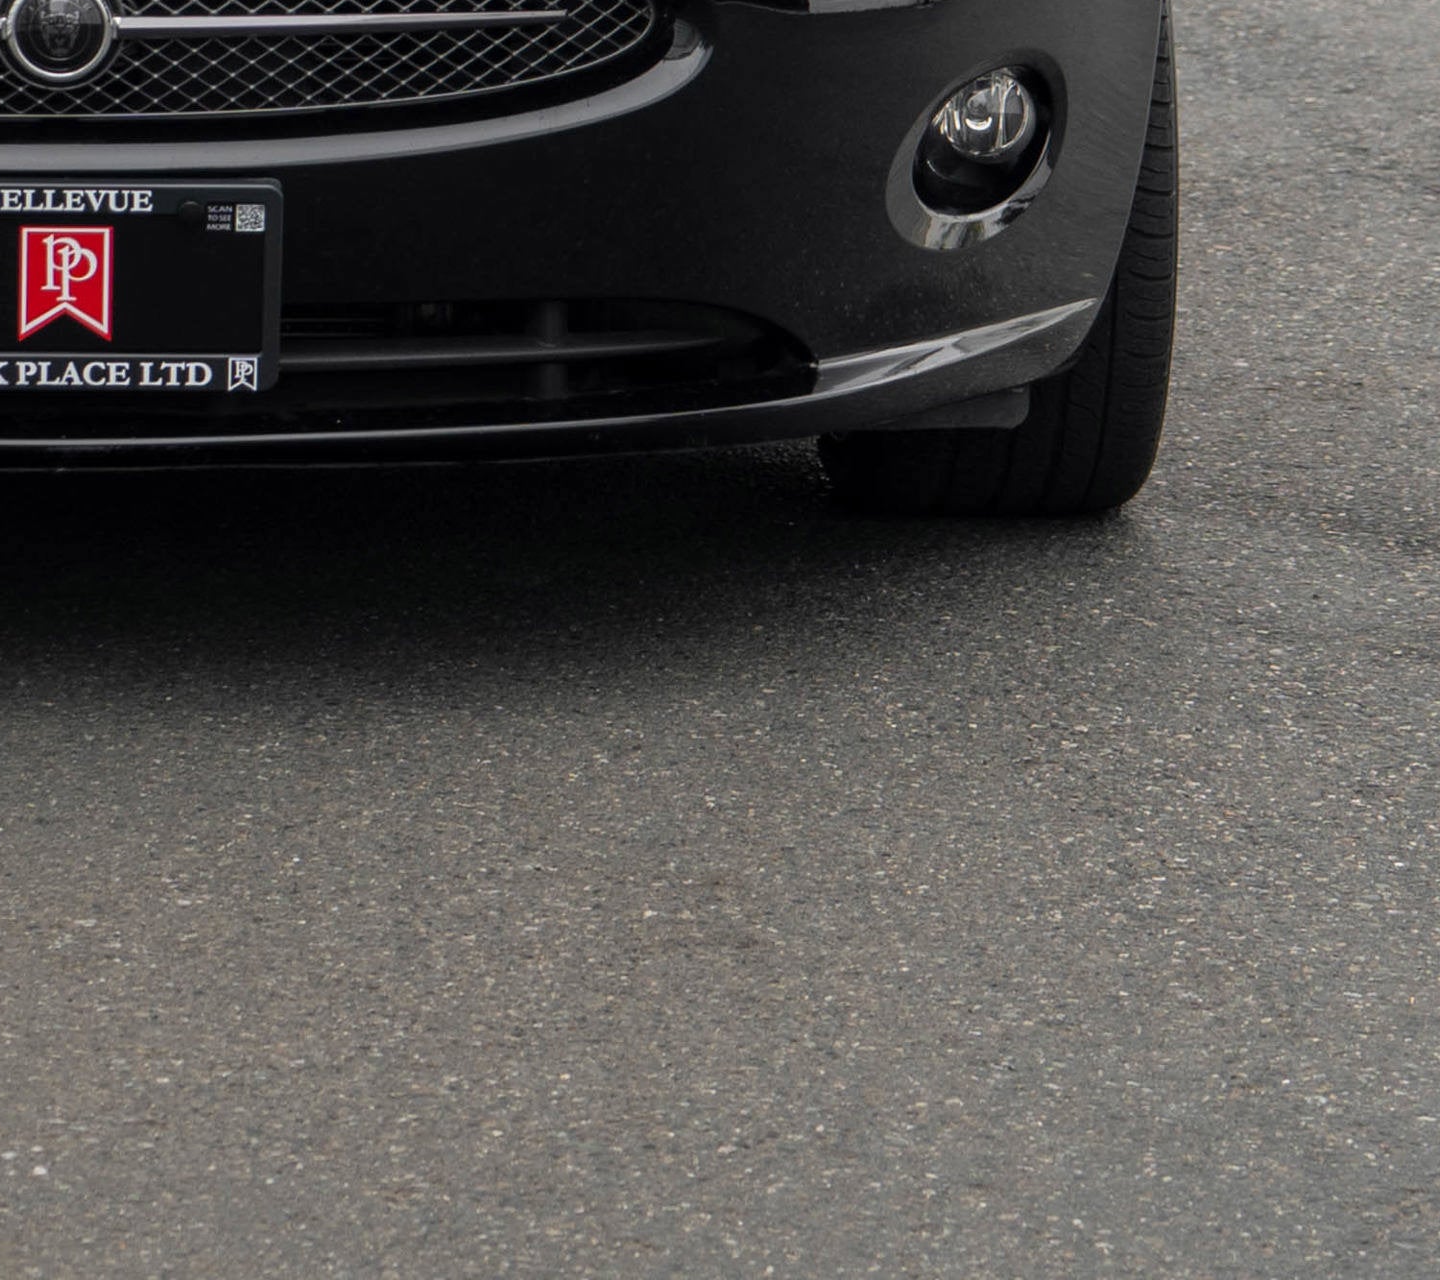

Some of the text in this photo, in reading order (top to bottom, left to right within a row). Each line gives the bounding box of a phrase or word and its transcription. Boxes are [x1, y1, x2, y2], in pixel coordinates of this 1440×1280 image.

[207, 205, 233, 213] SCAN
[15, 361, 130, 386] PLACE
[139, 362, 213, 386] LTD
